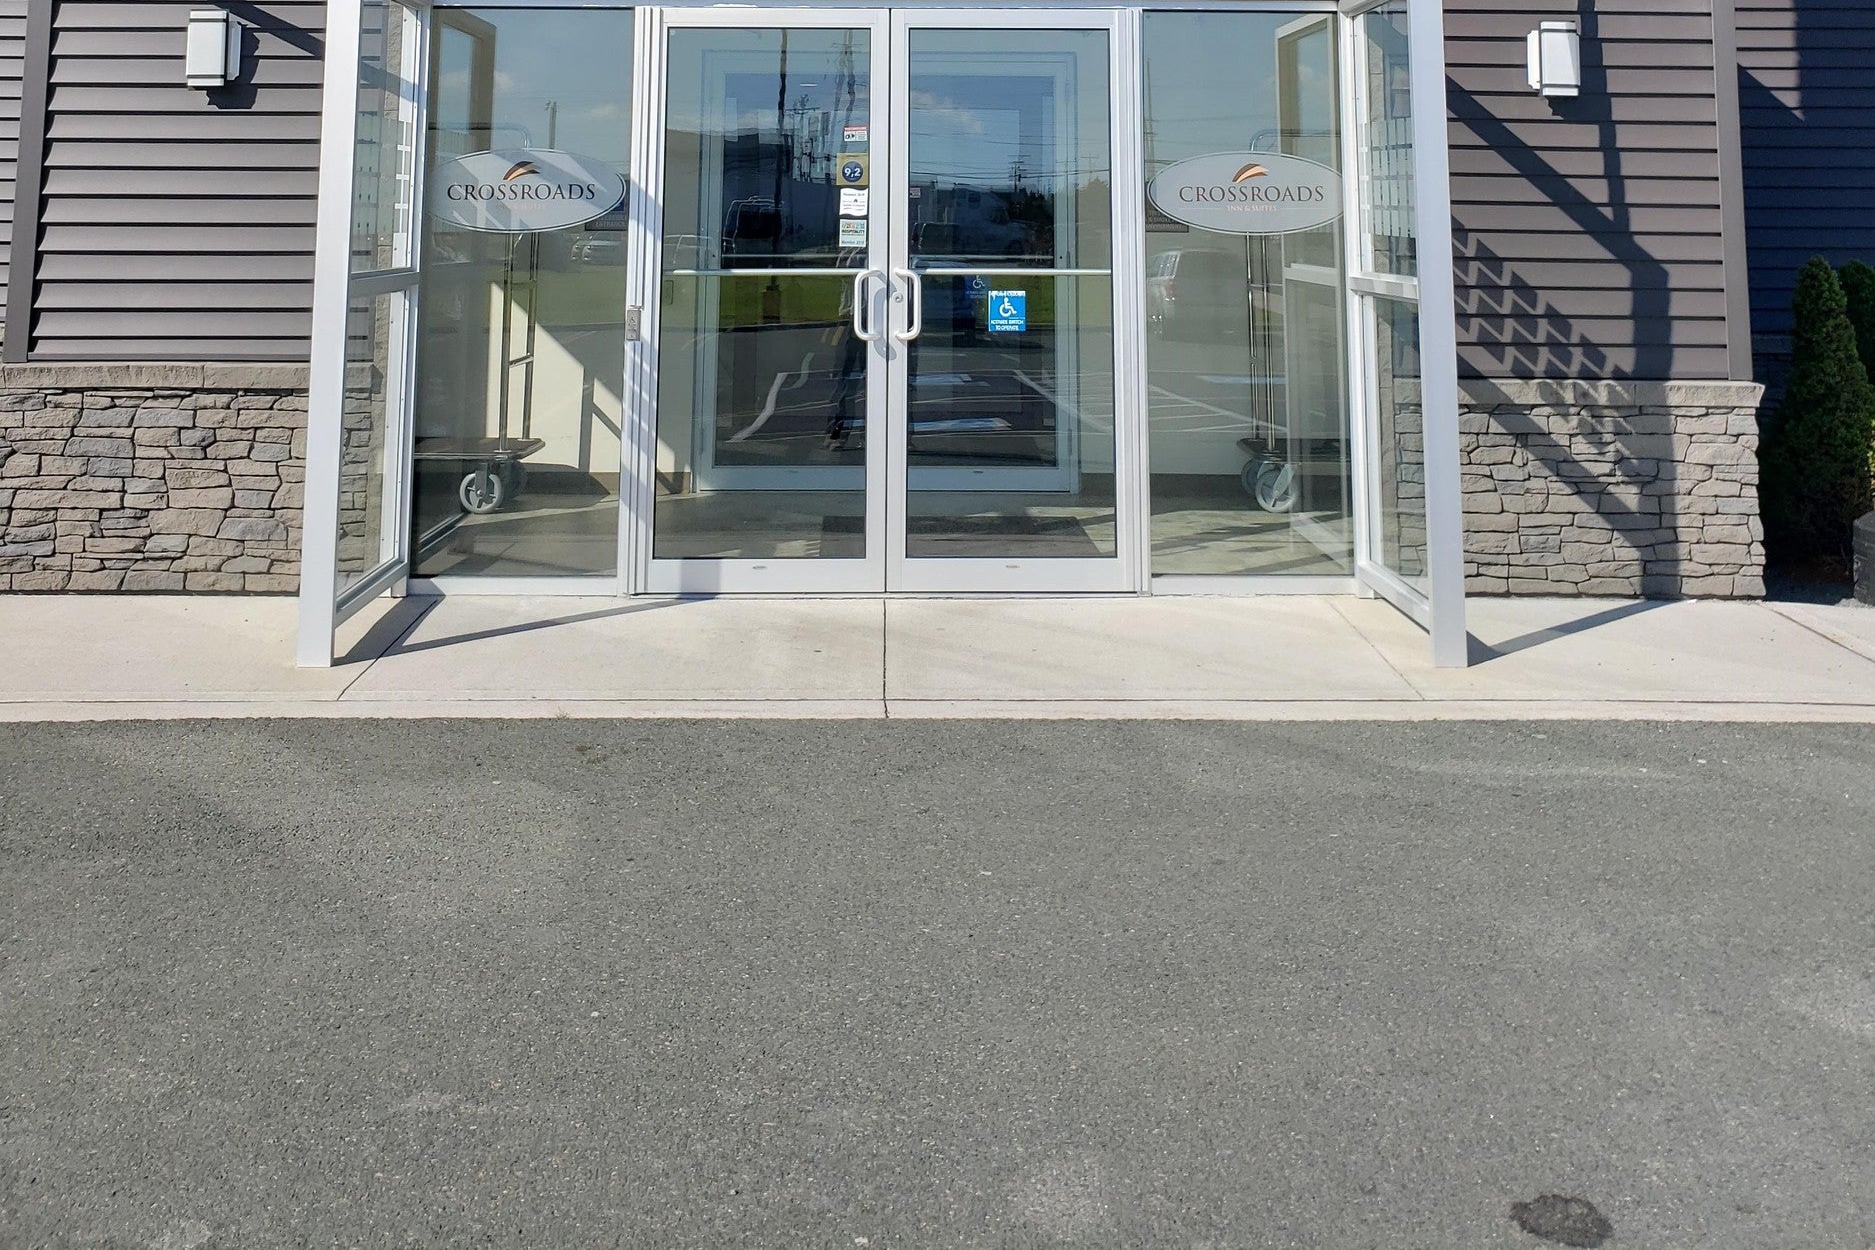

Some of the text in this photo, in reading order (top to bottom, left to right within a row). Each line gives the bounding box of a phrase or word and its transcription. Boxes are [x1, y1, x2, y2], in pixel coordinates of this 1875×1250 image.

[447, 183, 596, 201] CROSSROADS
[1178, 185, 1324, 202] CROSSROADS
[1227, 204, 1244, 212] INN
[1251, 204, 1277, 212] SUITES
